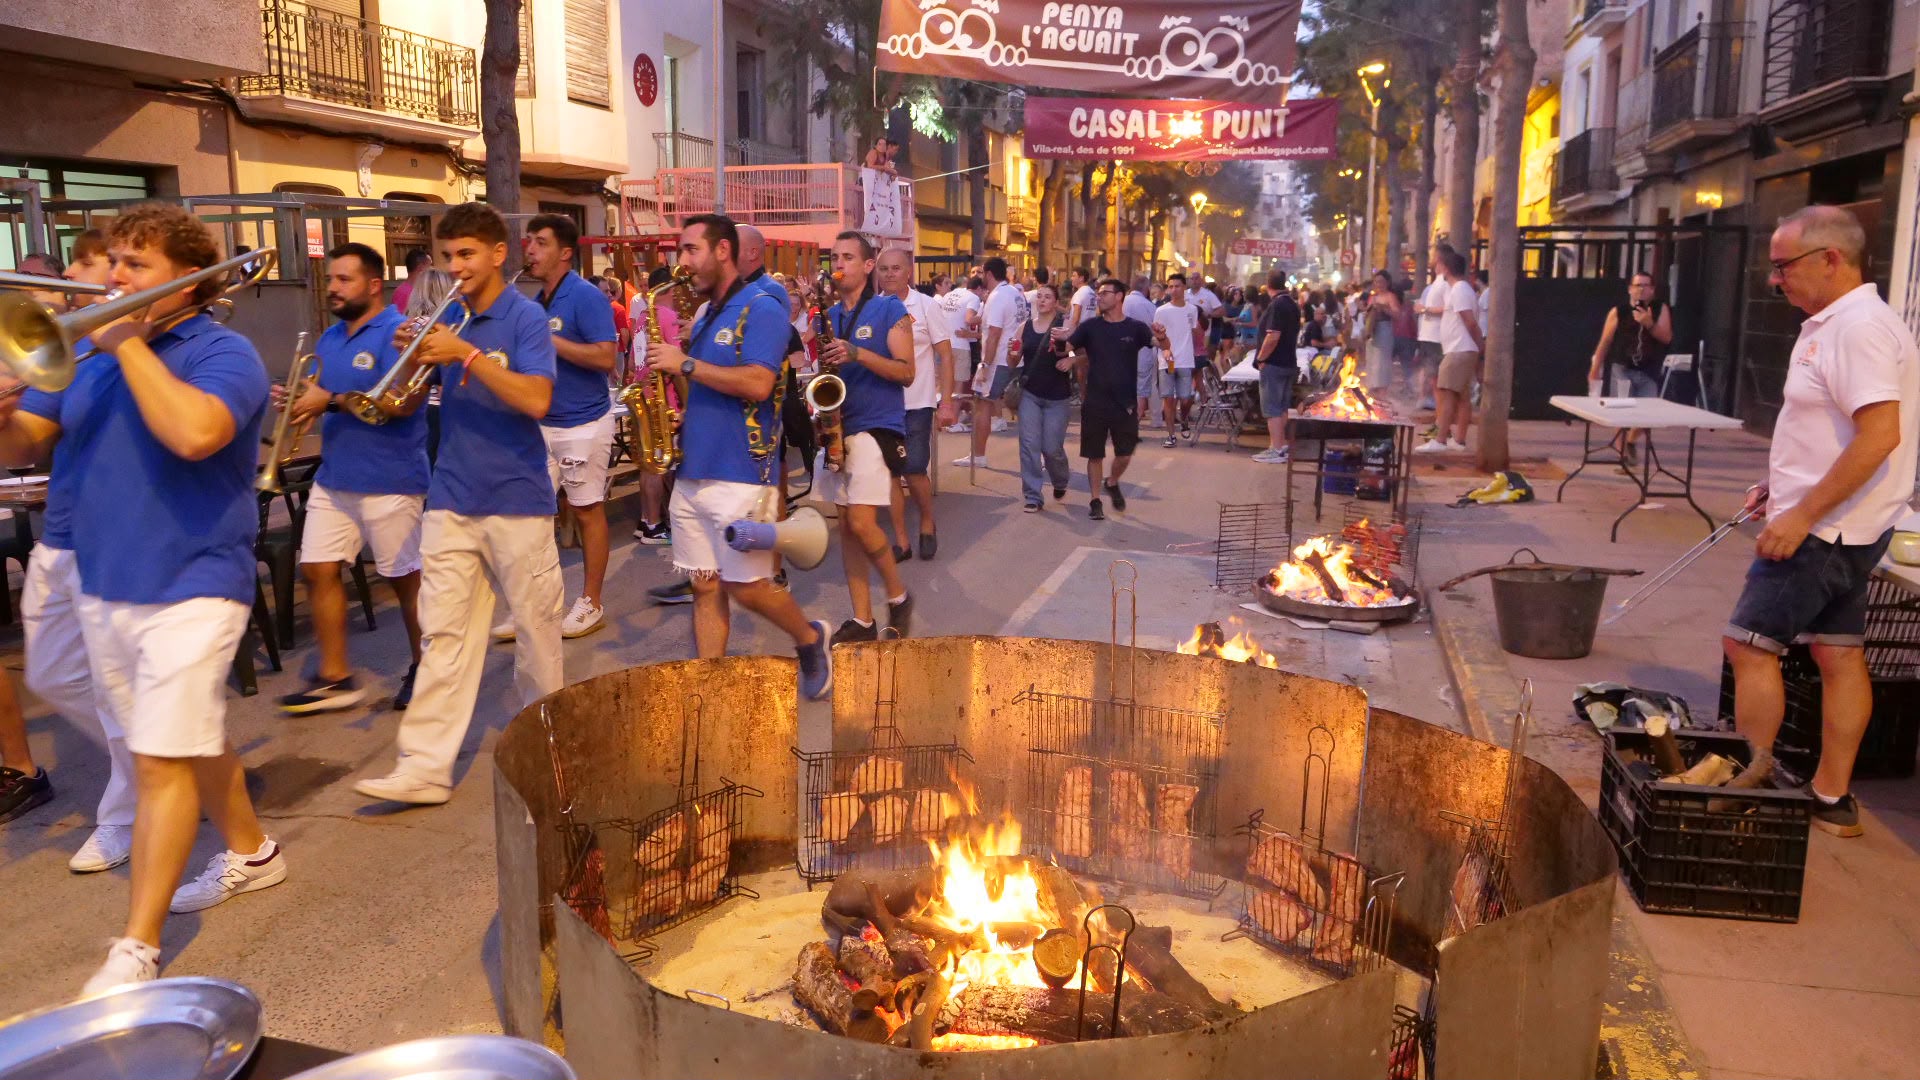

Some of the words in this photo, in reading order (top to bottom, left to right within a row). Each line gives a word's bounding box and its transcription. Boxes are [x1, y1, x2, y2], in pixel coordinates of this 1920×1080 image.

[1042, 2, 1124, 30] PENYA
[1021, 25, 1139, 56] L'AGUAIT
[1070, 107, 1161, 140] CASAL
[1212, 108, 1291, 140] PUNT
[1032, 144, 1074, 156] Vila-real,
[1076, 145, 1094, 154] des
[1096, 145, 1110, 155] de
[1111, 145, 1136, 155] 1991
